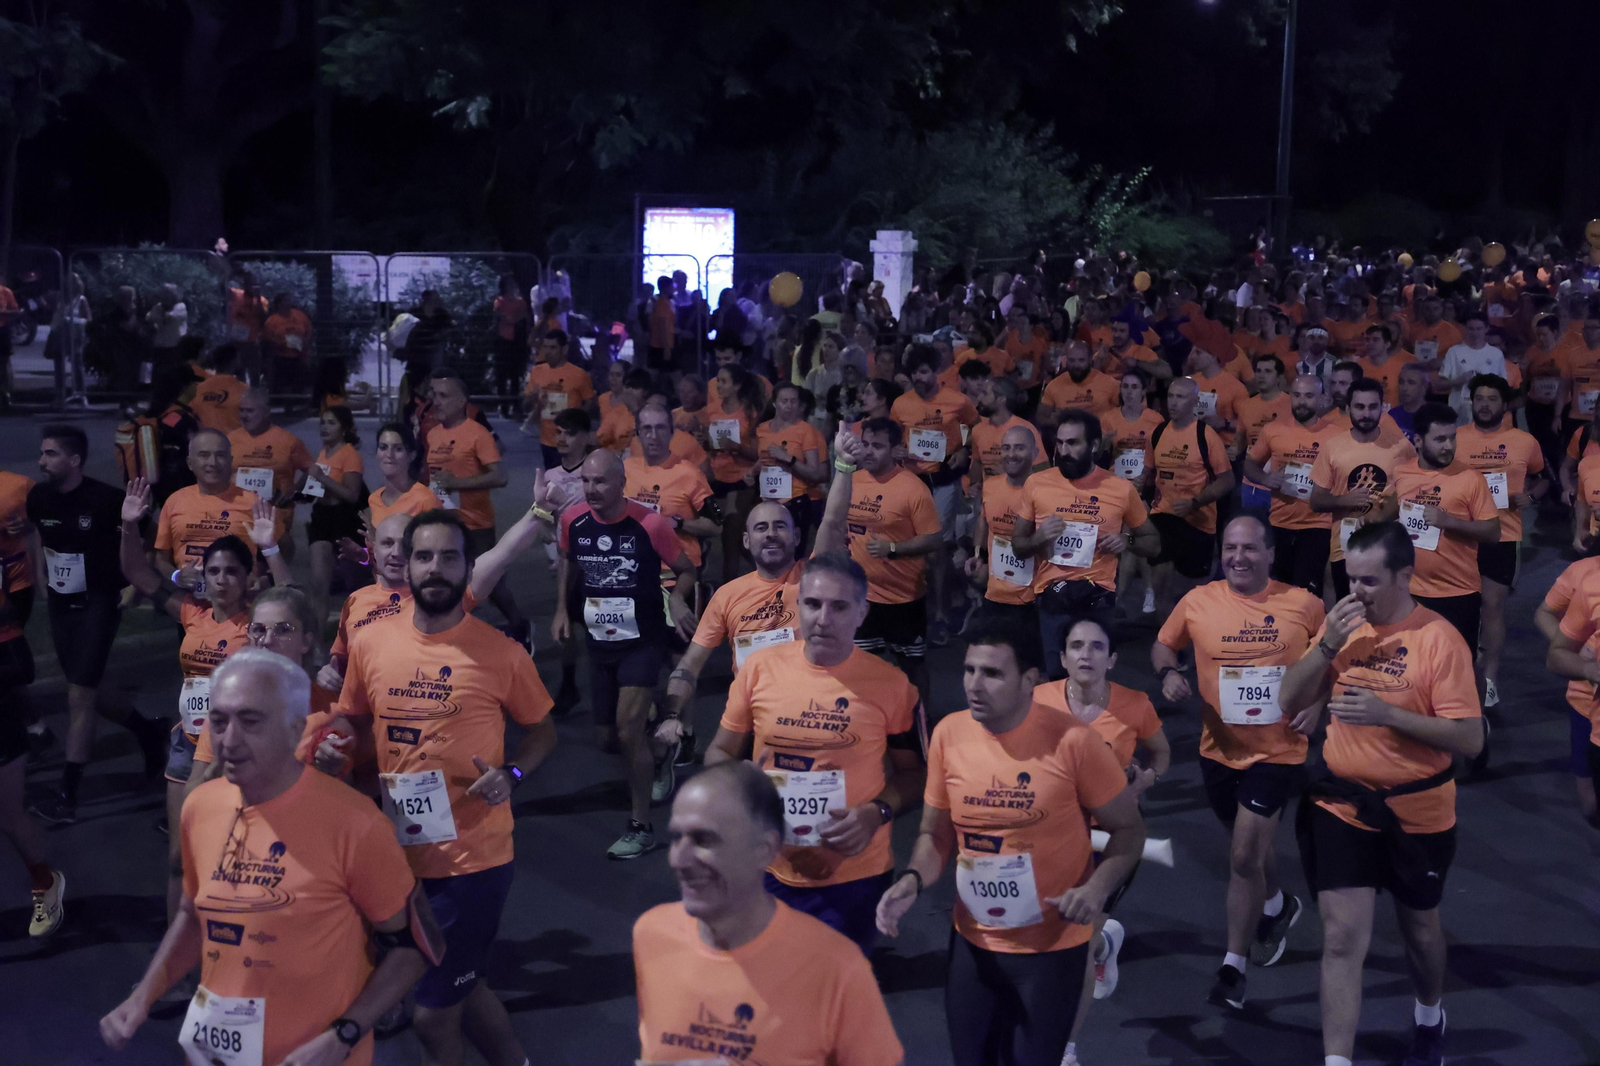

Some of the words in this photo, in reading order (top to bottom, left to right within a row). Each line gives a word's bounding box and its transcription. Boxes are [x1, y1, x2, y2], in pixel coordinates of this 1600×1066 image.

[917, 439, 939, 449] 20968
[244, 479, 266, 488] 14129
[766, 477, 782, 485] 5201
[992, 516, 1014, 525] SEVILLA
[1057, 536, 1083, 548] 4970
[1000, 553, 1026, 569] 11853
[595, 613, 624, 624] 20281
[1221, 635, 1257, 643] SEVILLA
[408, 680, 453, 692] NOCTURNA
[388, 687, 426, 699] SEVILLA
[1238, 686, 1271, 701] 7894
[776, 717, 821, 729] SEVILLA
[800, 711, 851, 723] NOCTURNA
[985, 789, 1035, 799] NOCTURNA
[391, 796, 432, 816] 11521
[963, 796, 1006, 808] SEVILLA
[231, 861, 286, 876] NOCTURNA
[211, 870, 251, 885] SEVILLA
[970, 880, 1020, 898] 13008
[193, 1021, 242, 1053] 21698
[661, 1032, 716, 1053] SEVILLA
